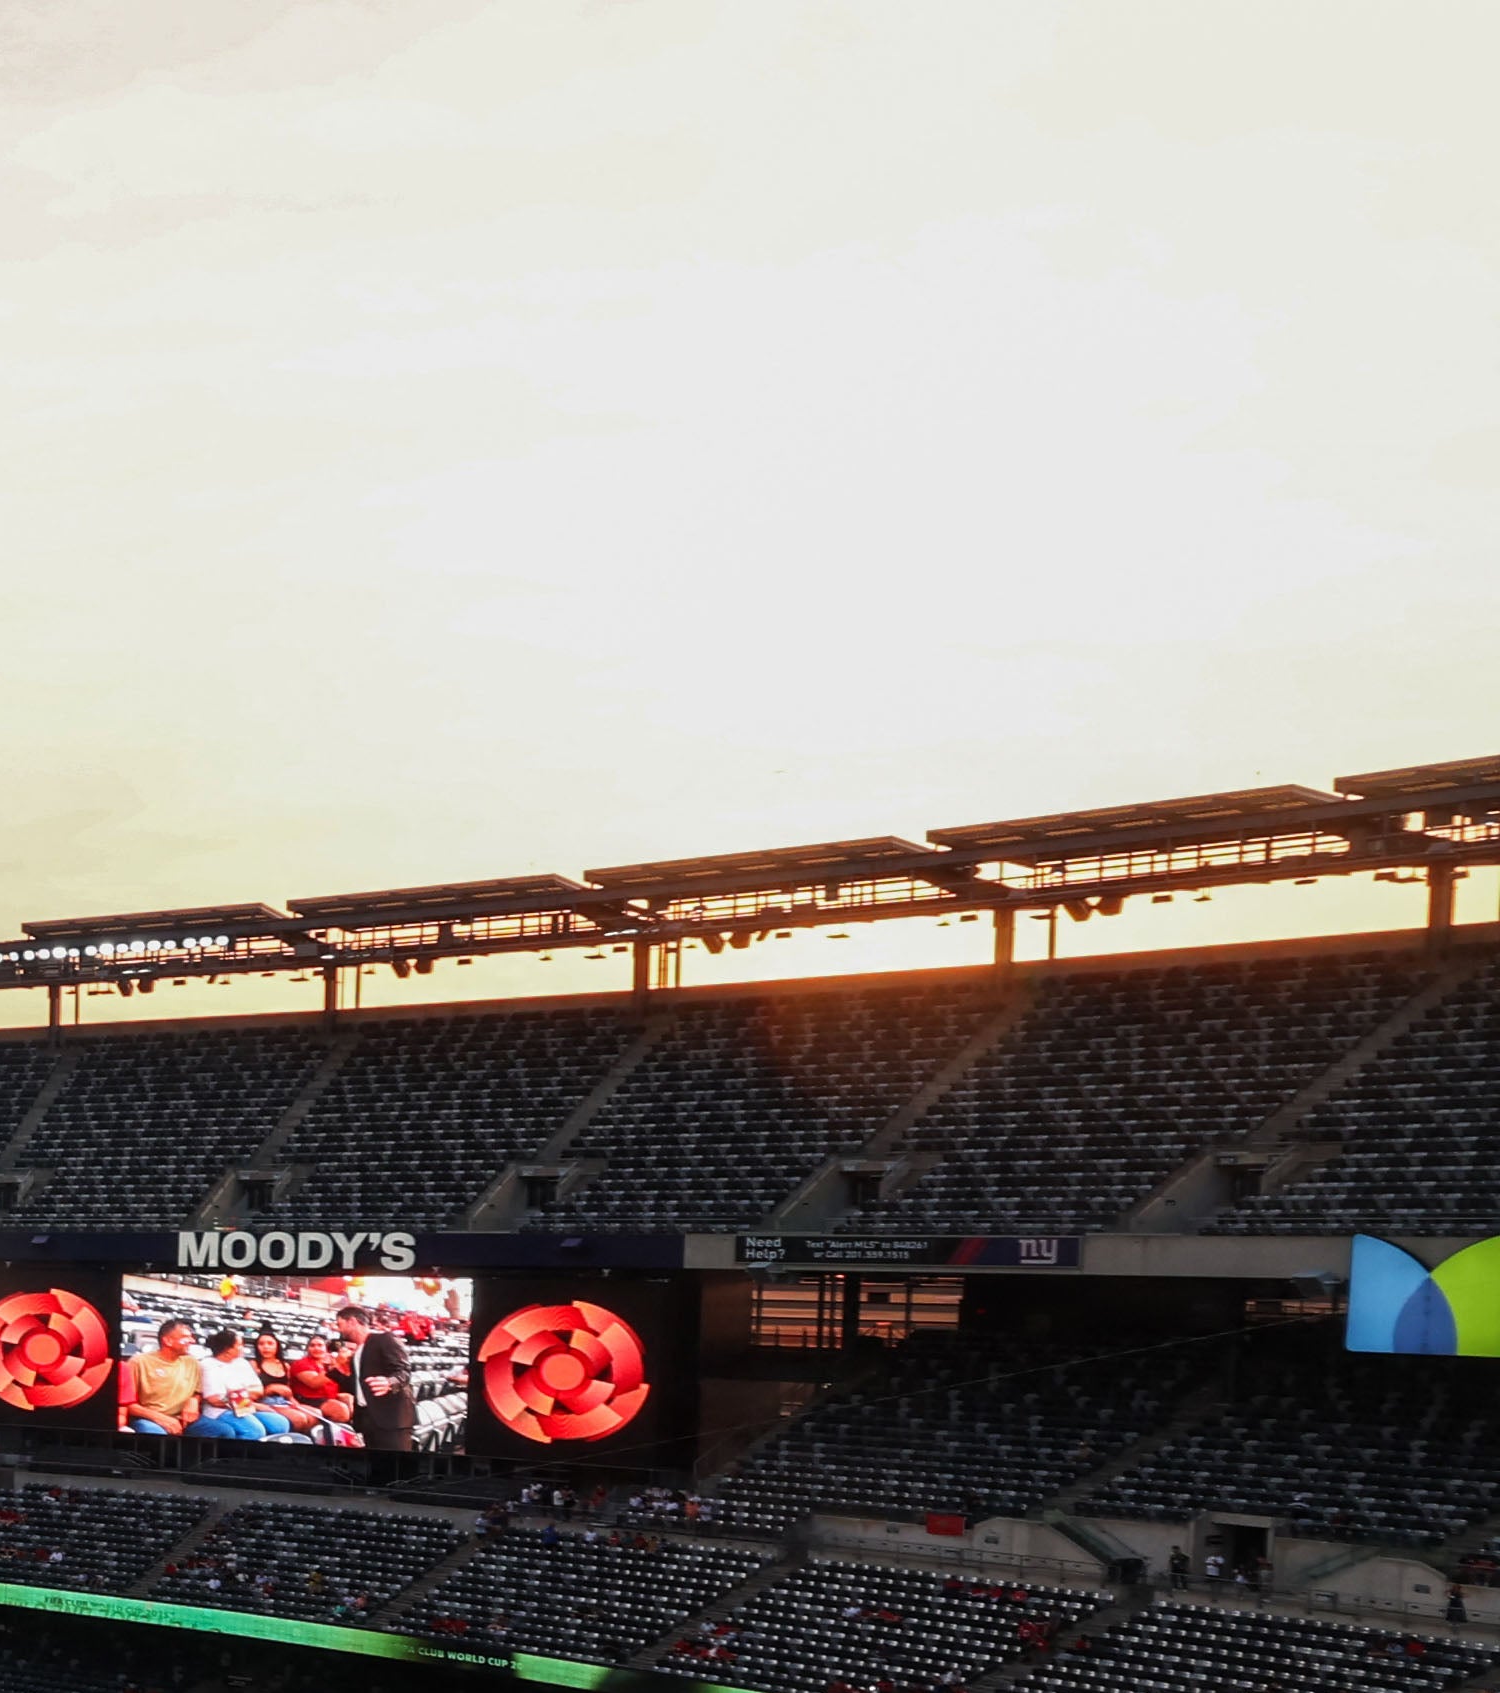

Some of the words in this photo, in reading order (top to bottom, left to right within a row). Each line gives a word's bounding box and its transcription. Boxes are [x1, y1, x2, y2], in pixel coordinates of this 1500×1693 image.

[746, 1237, 782, 1248] Need
[177, 1231, 416, 1270] MOODY'S
[745, 1248, 786, 1260] Help?
[446, 1649, 486, 1665] WORLD
[486, 1654, 508, 1667] CUP
